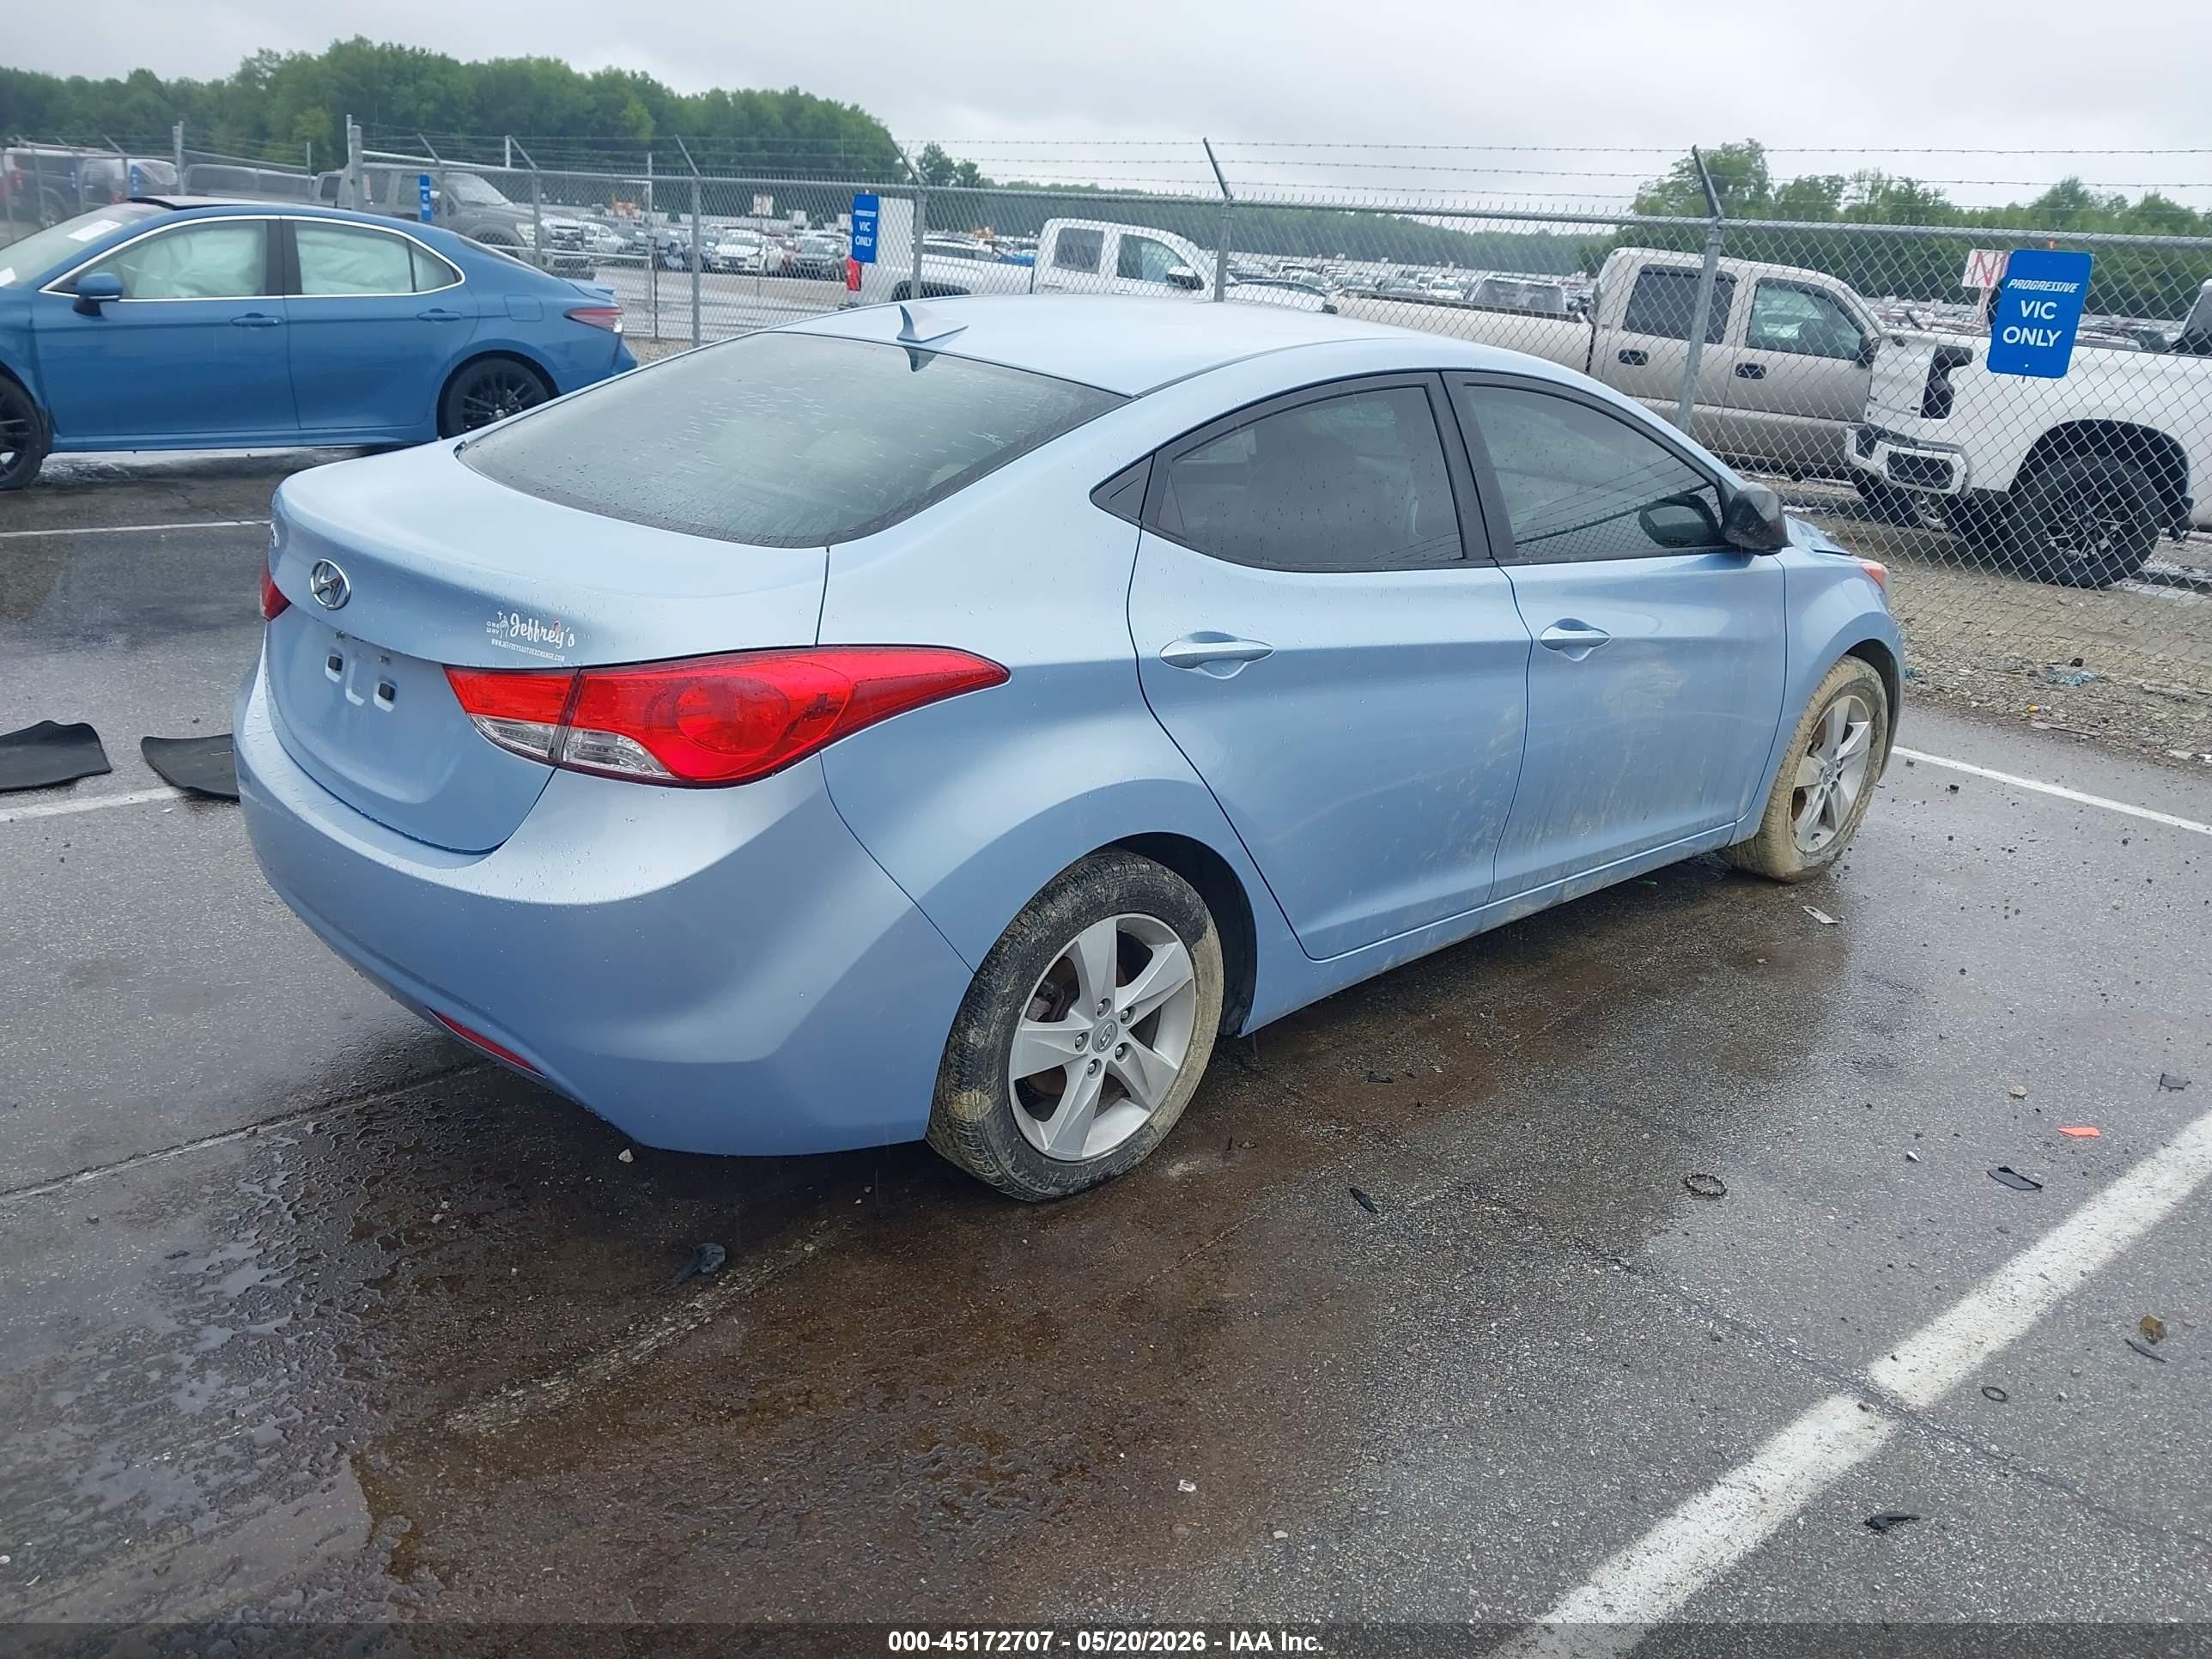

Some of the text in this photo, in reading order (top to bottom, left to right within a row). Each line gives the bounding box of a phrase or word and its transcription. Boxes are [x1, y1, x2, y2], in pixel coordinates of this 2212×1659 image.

[860, 222, 872, 232] VIC
[855, 235, 872, 246] ONLY
[2007, 278, 2081, 294] PROGRESSIVE
[2021, 300, 2057, 319] VIC
[2002, 326, 2062, 347] ONLY
[510, 612, 575, 649] Jeffrey's
